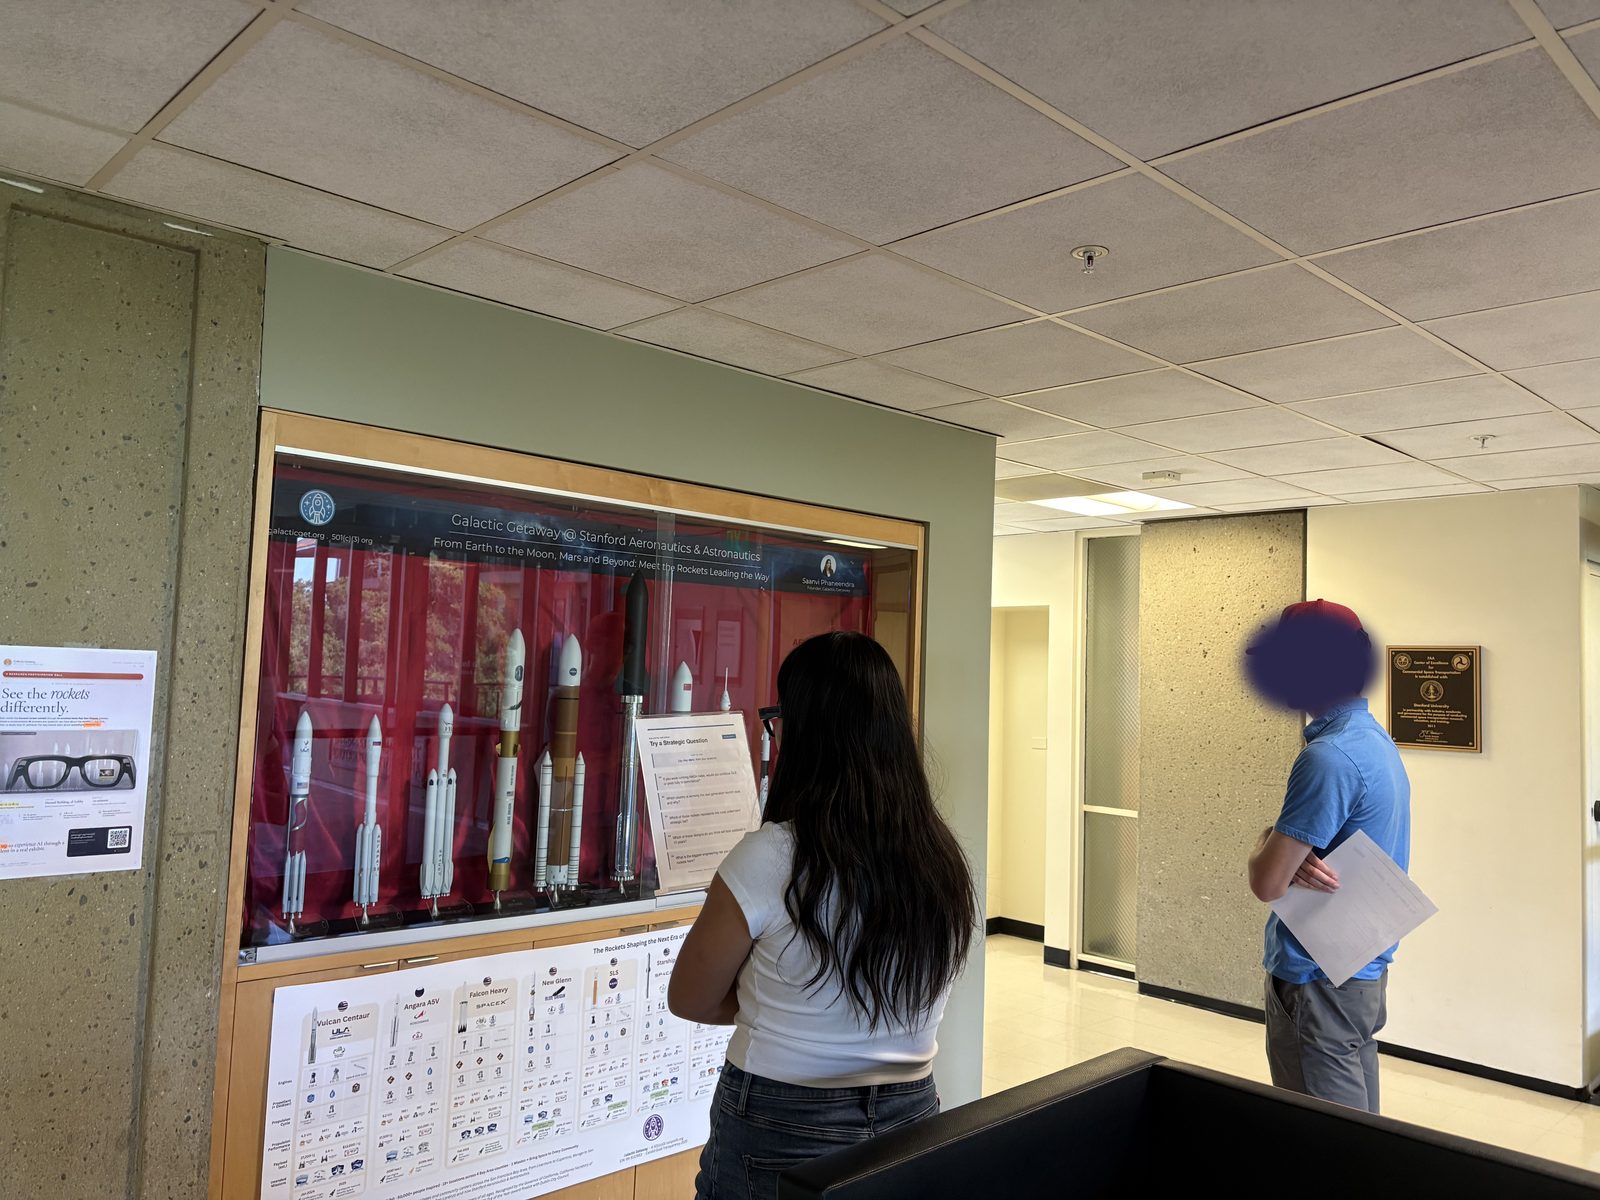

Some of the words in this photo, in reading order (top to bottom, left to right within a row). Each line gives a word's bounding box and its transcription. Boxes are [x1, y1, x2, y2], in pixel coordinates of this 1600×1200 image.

[331, 533, 360, 544] 501(c)(3)
[361, 537, 373, 546] org
[451, 514, 503, 531] Galactic
[506, 521, 560, 540] Getaway
[564, 528, 576, 542] @
[579, 530, 626, 546] Stanford
[628, 536, 691, 555] Aeronautics
[693, 545, 701, 555] &
[702, 545, 761, 562] Astronautics
[434, 537, 462, 549] From
[465, 540, 492, 552] Earth
[495, 544, 505, 554] to
[508, 545, 524, 556] the
[526, 548, 557, 560] Moon,
[559, 552, 582, 563] Mars
[583, 554, 600, 564] and
[602, 557, 636, 568] Beyond:
[638, 560, 661, 570] Meet
[662, 563, 675, 572] the
[677, 564, 708, 576] Rockets
[709, 568, 739, 580] Leading
[740, 571, 753, 580] the
[754, 572, 769, 583] Way
[2, 687, 23, 699] See
[27, 687, 47, 699] the
[51, 687, 90, 700] rockets
[0, 700, 69, 716] differently.
[663, 739, 685, 747] Strategic
[685, 737, 708, 745] Question
[604, 943, 626, 953] Rockets
[626, 940, 647, 949] Shaping
[656, 957, 676, 966] Starship
[469, 990, 489, 998] Falcon
[490, 987, 508, 995] Heavy
[404, 1001, 426, 1010] Angara
[427, 998, 440, 1006] A5V
[317, 1018, 341, 1026] Vulcan
[342, 1013, 370, 1022] Centaur
